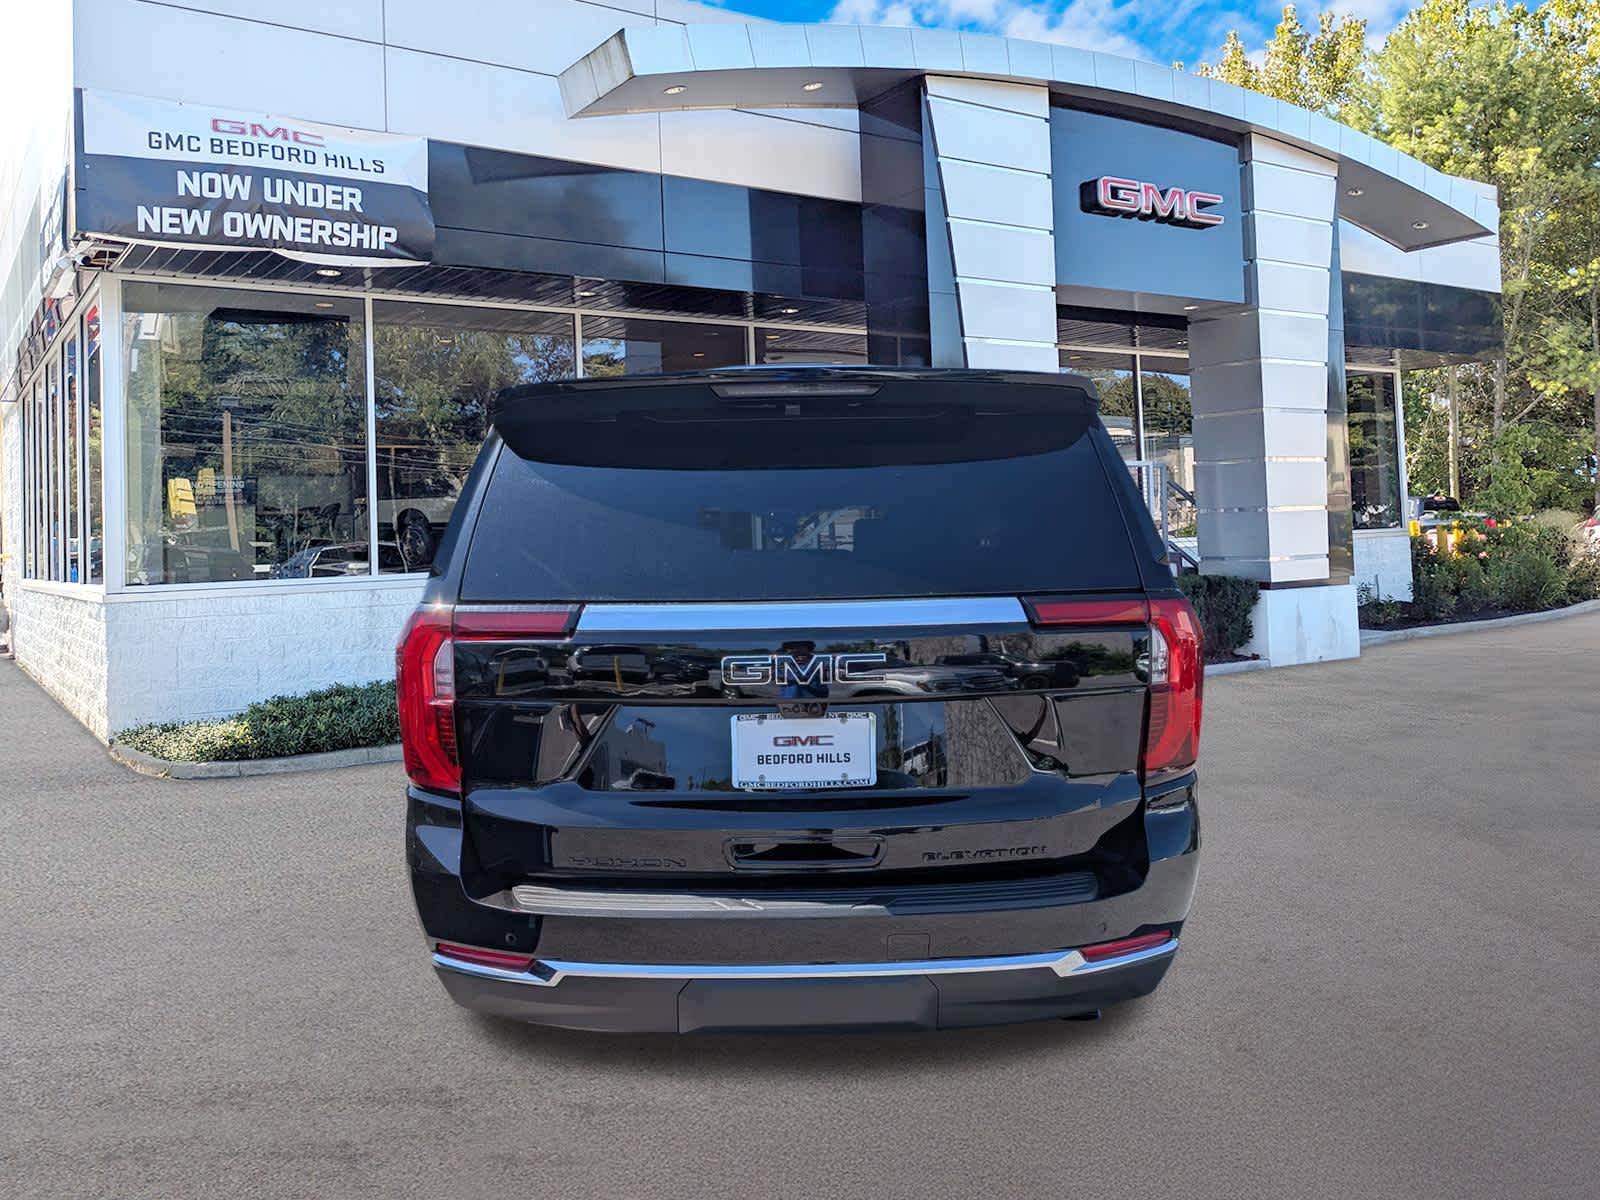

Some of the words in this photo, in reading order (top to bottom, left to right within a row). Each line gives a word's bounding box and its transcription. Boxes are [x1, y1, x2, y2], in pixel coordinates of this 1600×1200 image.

[211, 118, 326, 147] GMC
[148, 131, 201, 153] GMC
[210, 137, 317, 166] BEDFORD
[324, 152, 386, 174] HILLS
[177, 169, 252, 201] NOW
[264, 178, 363, 213] UNDER
[1096, 175, 1225, 225] GMC
[137, 205, 212, 236] NEW
[223, 211, 398, 250] OWNERSHIP
[721, 653, 887, 686] GMC
[757, 753, 813, 765] BEDFORD
[816, 752, 851, 764] HILLS
[773, 735, 835, 747] GMC
